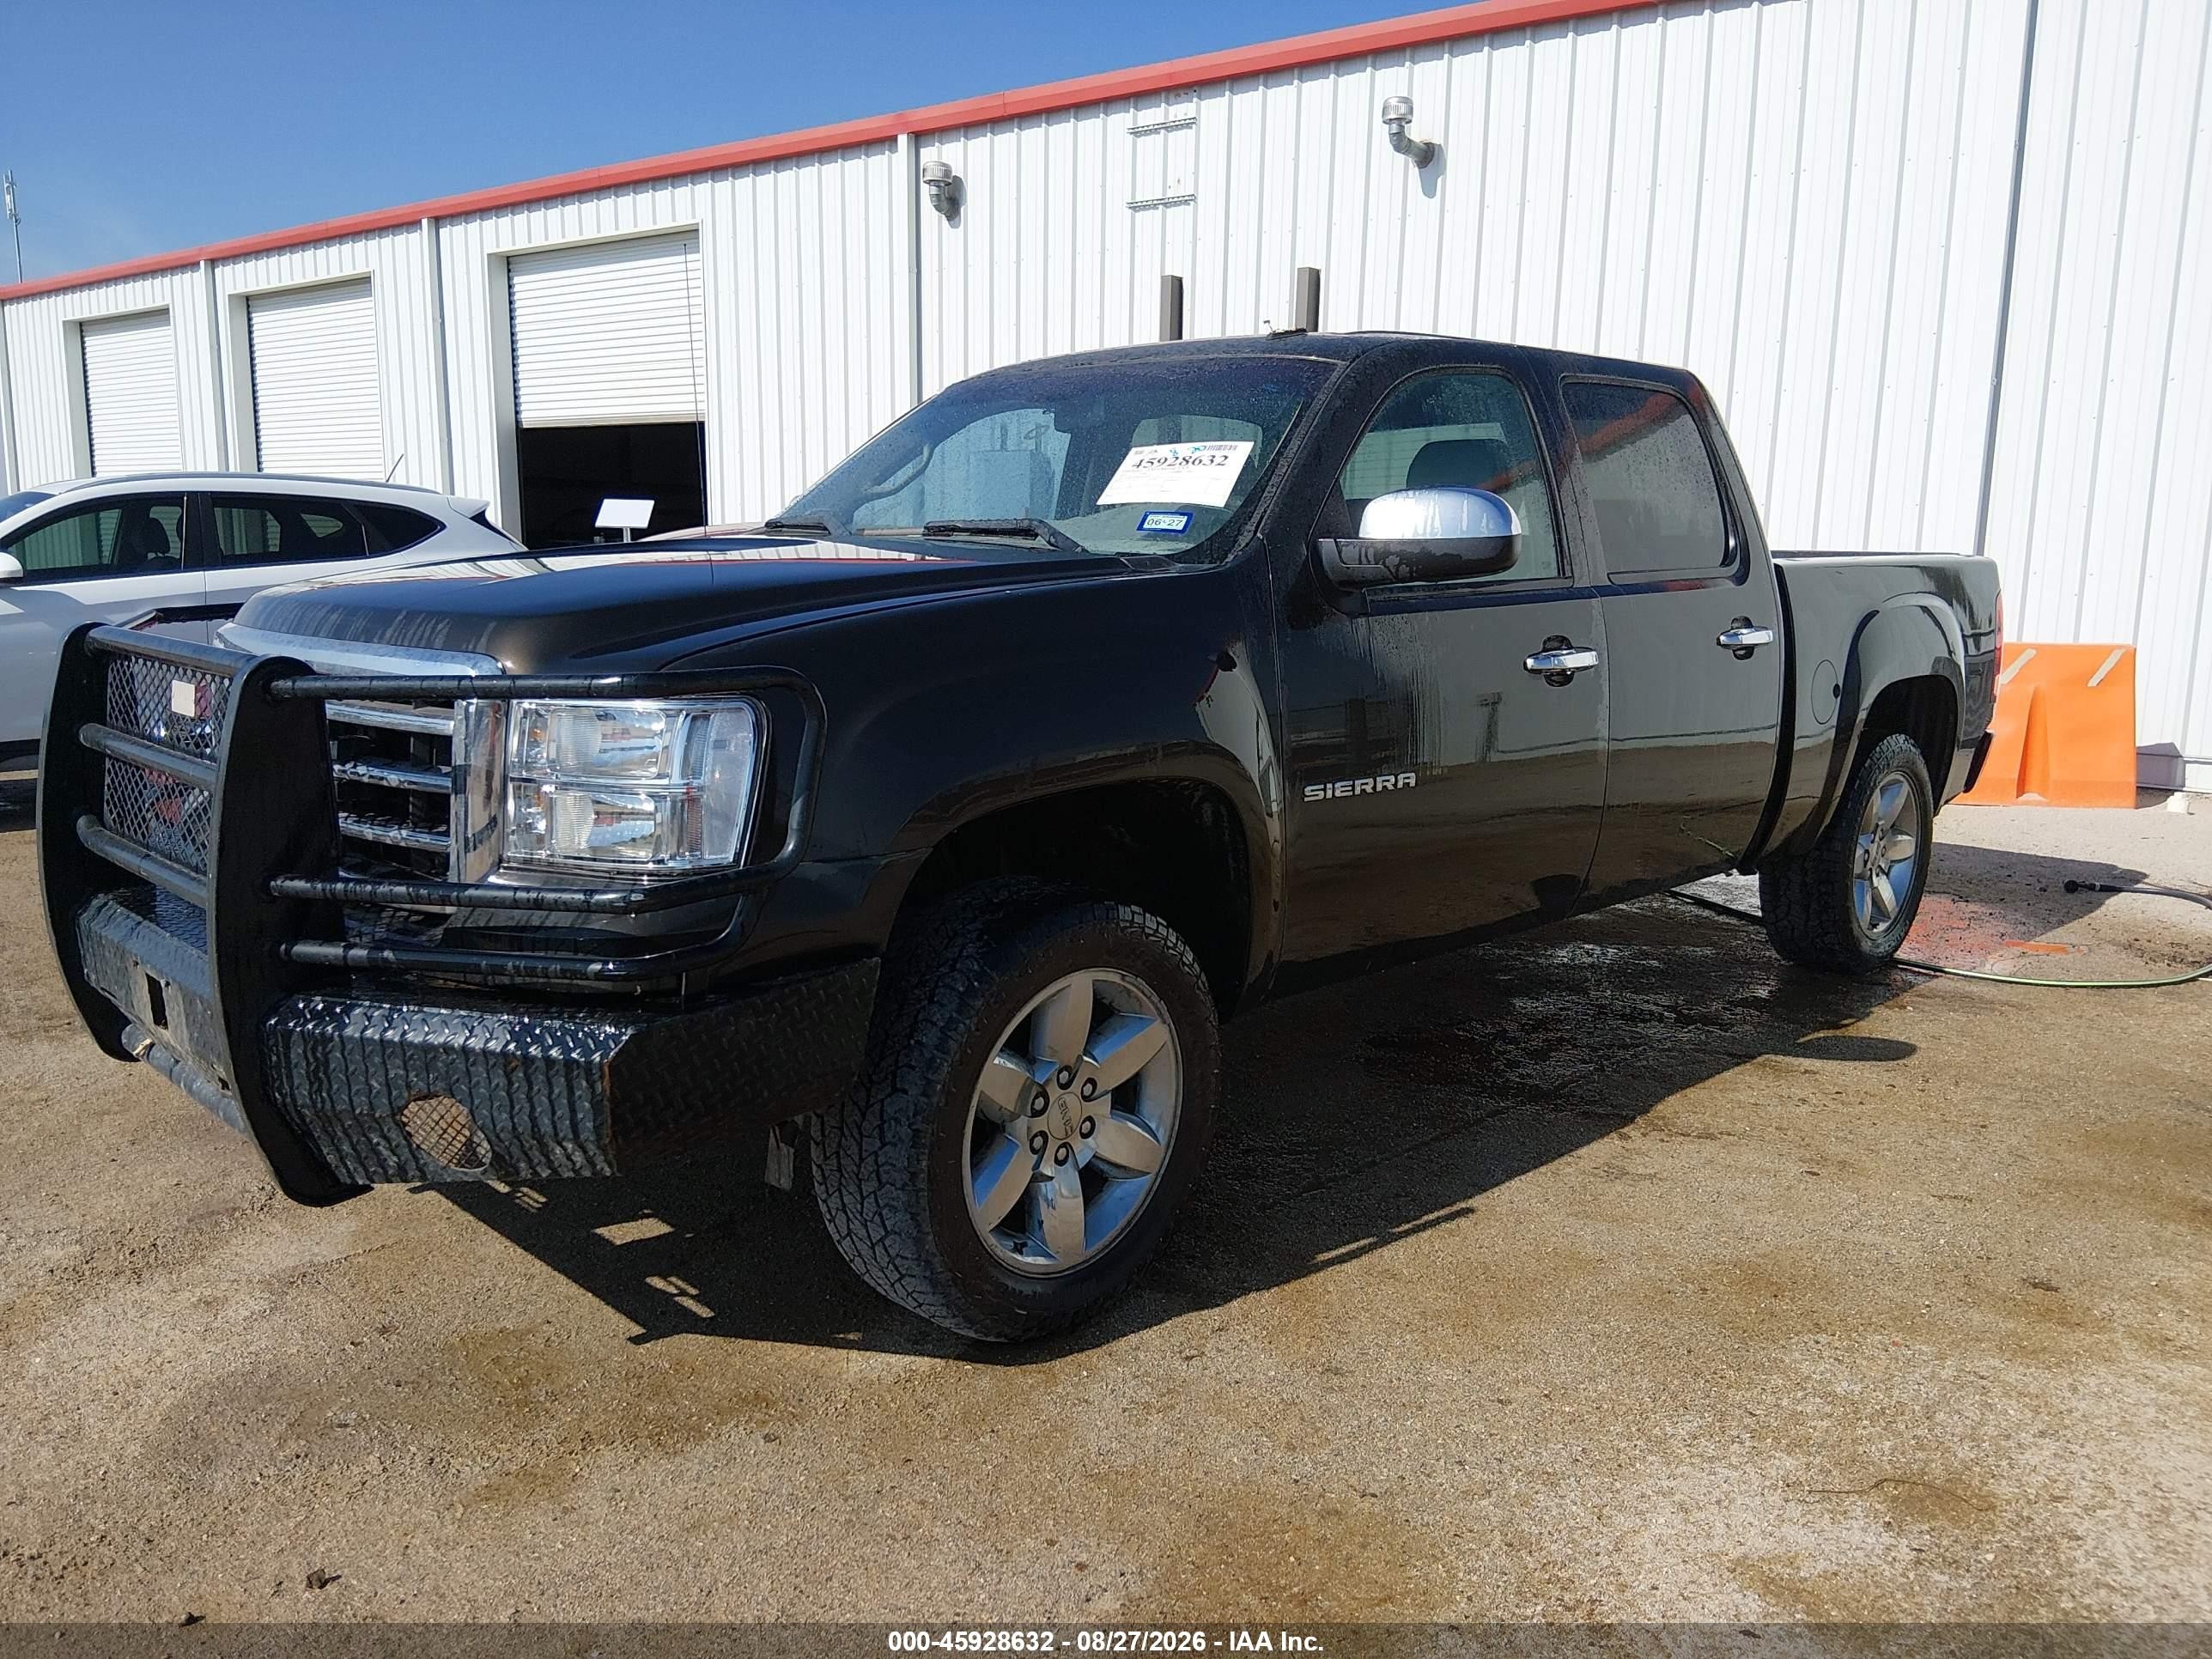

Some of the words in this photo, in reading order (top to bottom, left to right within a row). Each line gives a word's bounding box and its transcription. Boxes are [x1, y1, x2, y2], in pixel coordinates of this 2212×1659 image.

[1133, 454, 1229, 468] 45928632
[1146, 518, 1162, 526] 06
[1304, 772, 1416, 803] SIERRA
